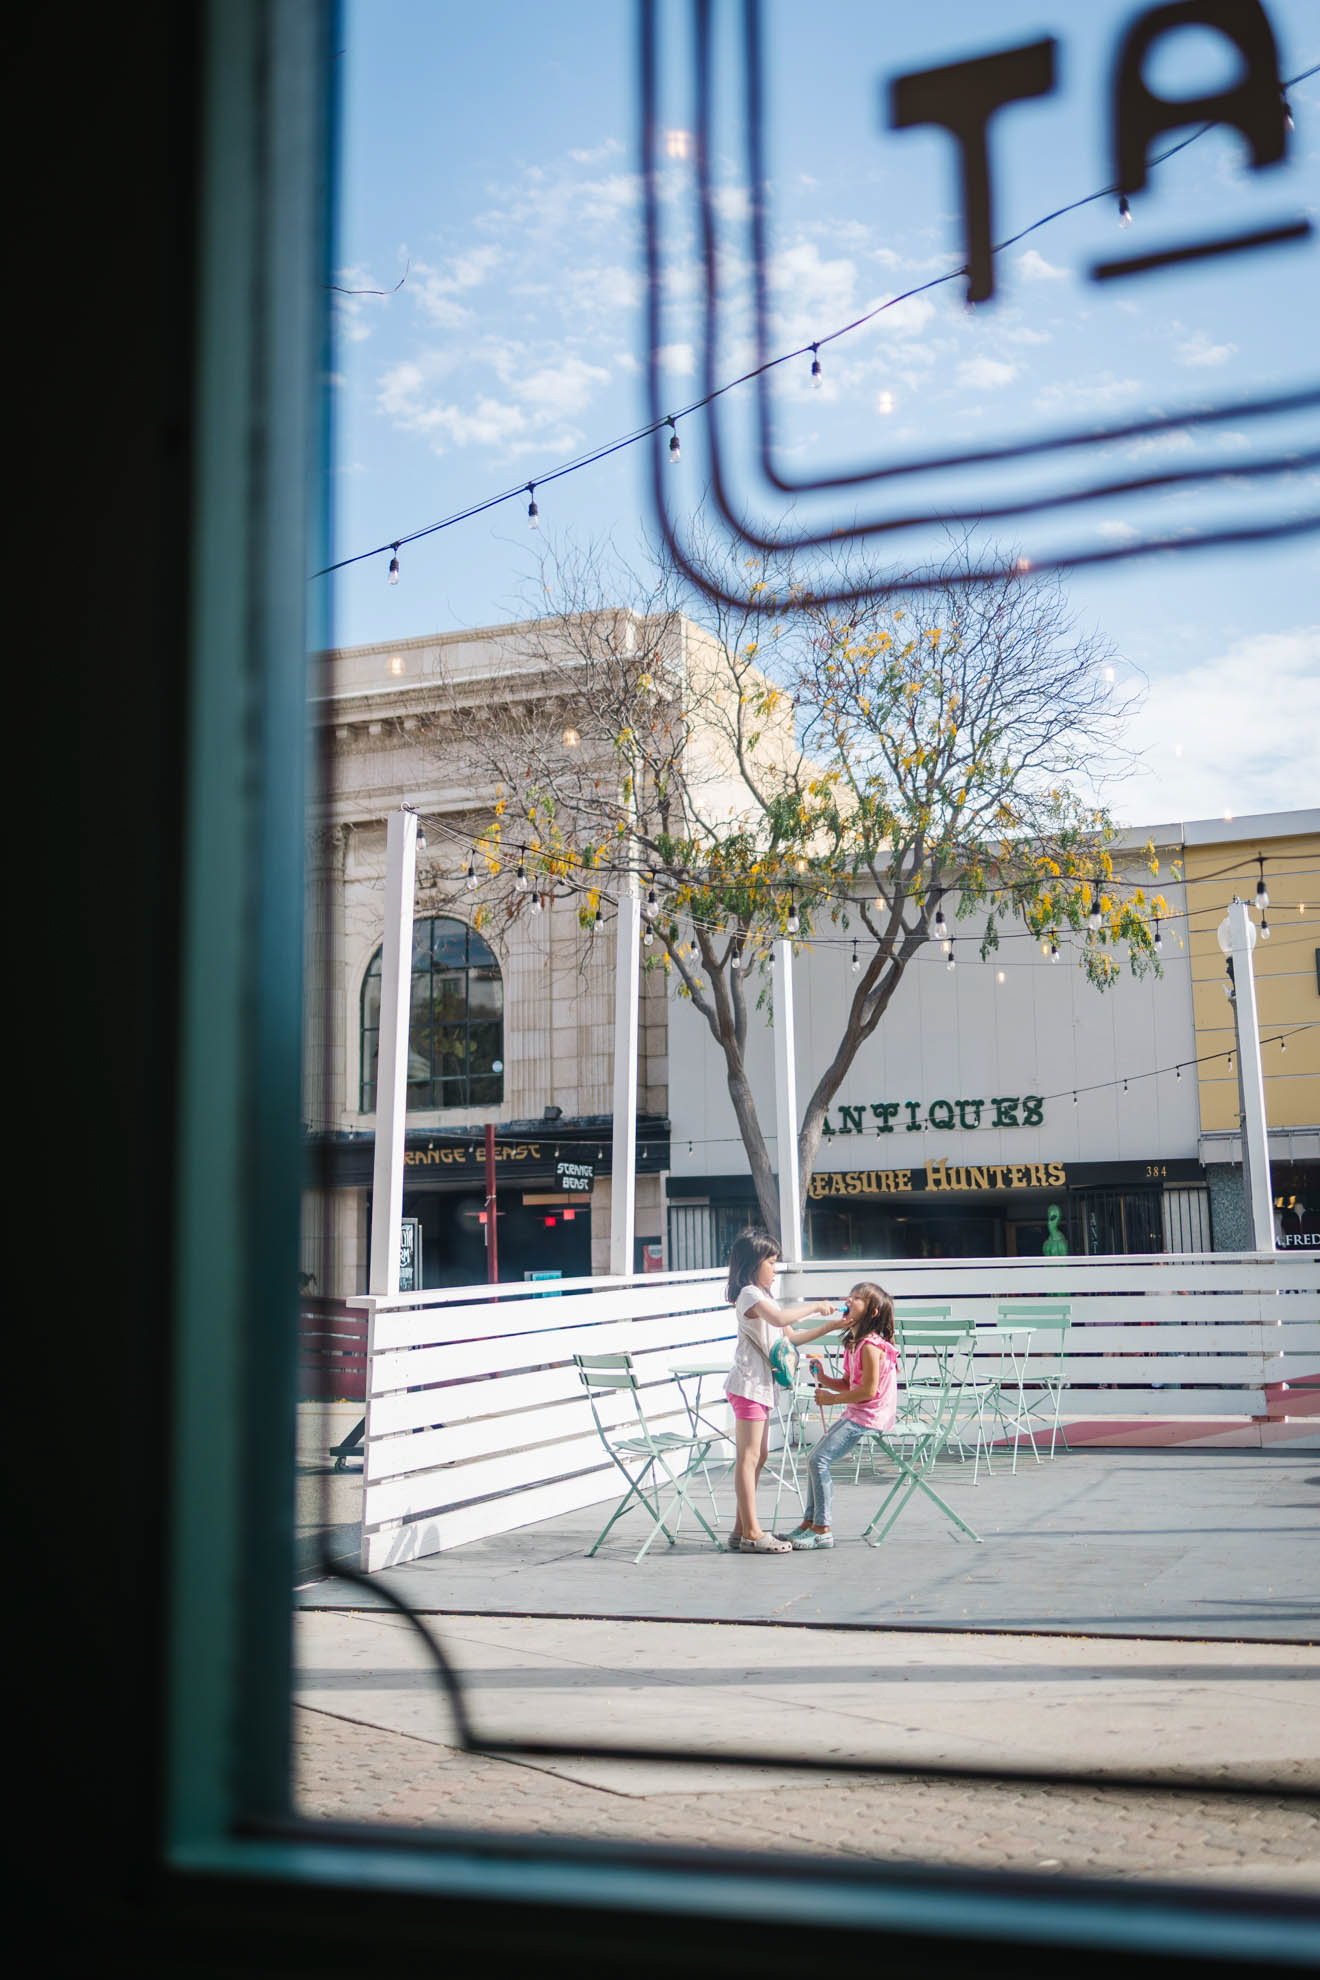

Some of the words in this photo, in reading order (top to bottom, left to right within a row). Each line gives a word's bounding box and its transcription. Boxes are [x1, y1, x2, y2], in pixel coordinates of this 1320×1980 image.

[405, 1148, 466, 1165] RANGE
[557, 1162, 593, 1177] STRANGE
[1145, 1165, 1167, 1177] 384
[562, 1176, 589, 1190] BEAST
[808, 1169, 912, 1199] EASURE
[924, 1157, 1066, 1191] HUNTERS
